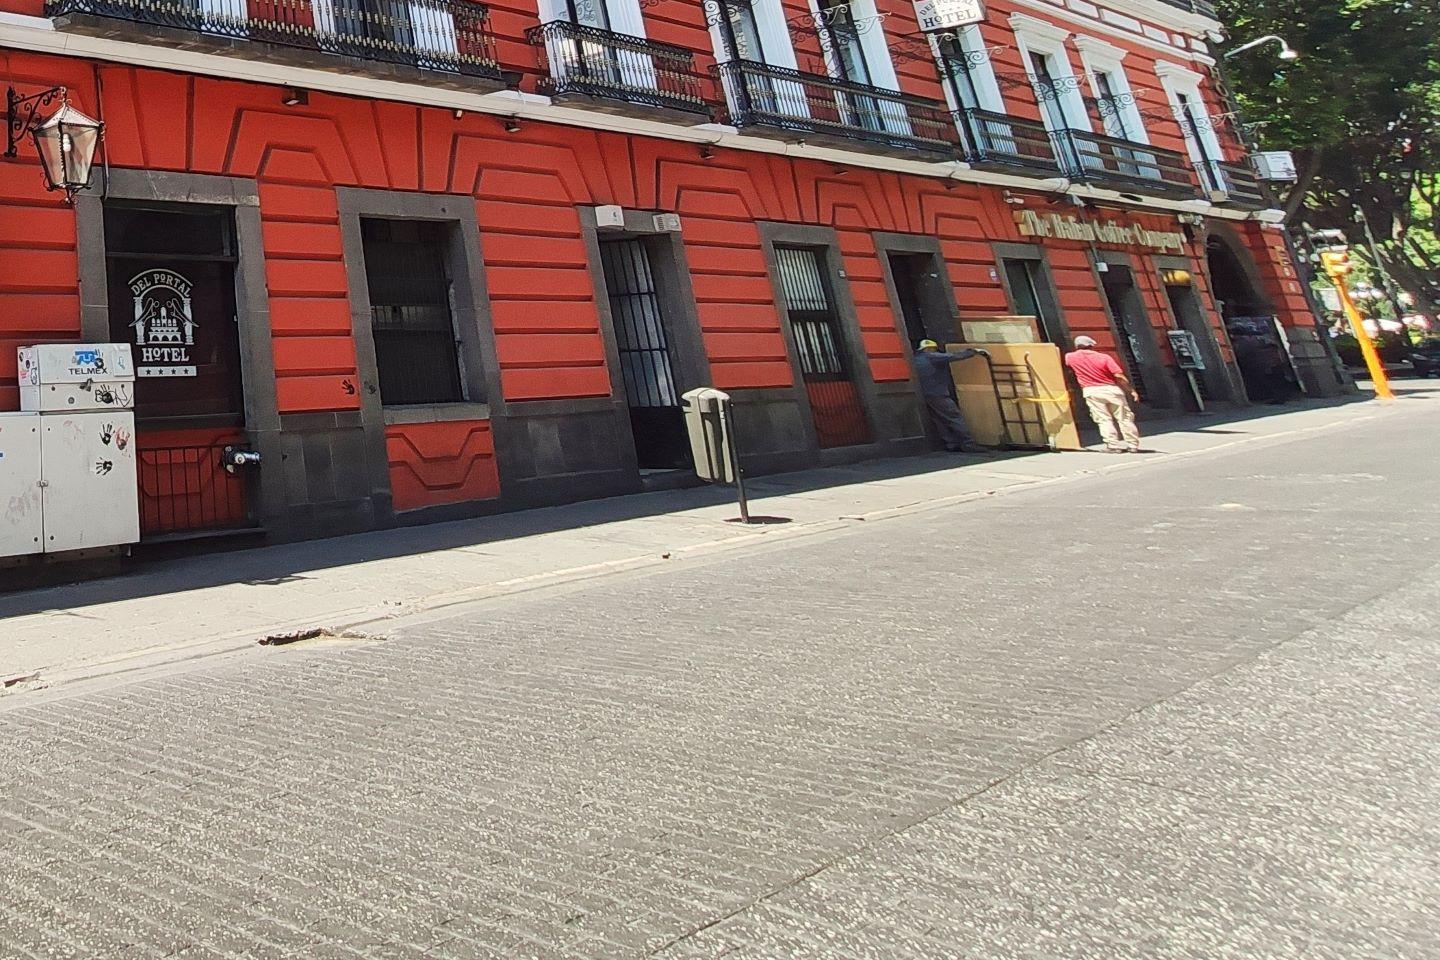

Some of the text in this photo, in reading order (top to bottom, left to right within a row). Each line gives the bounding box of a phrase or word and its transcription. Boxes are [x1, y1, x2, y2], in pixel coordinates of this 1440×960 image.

[919, 1, 936, 16] DEL
[922, 8, 977, 29] HOTEL
[130, 273, 192, 298] DEL PORTAL
[141, 347, 190, 362] HOTEL
[68, 367, 109, 376] TELMEX
